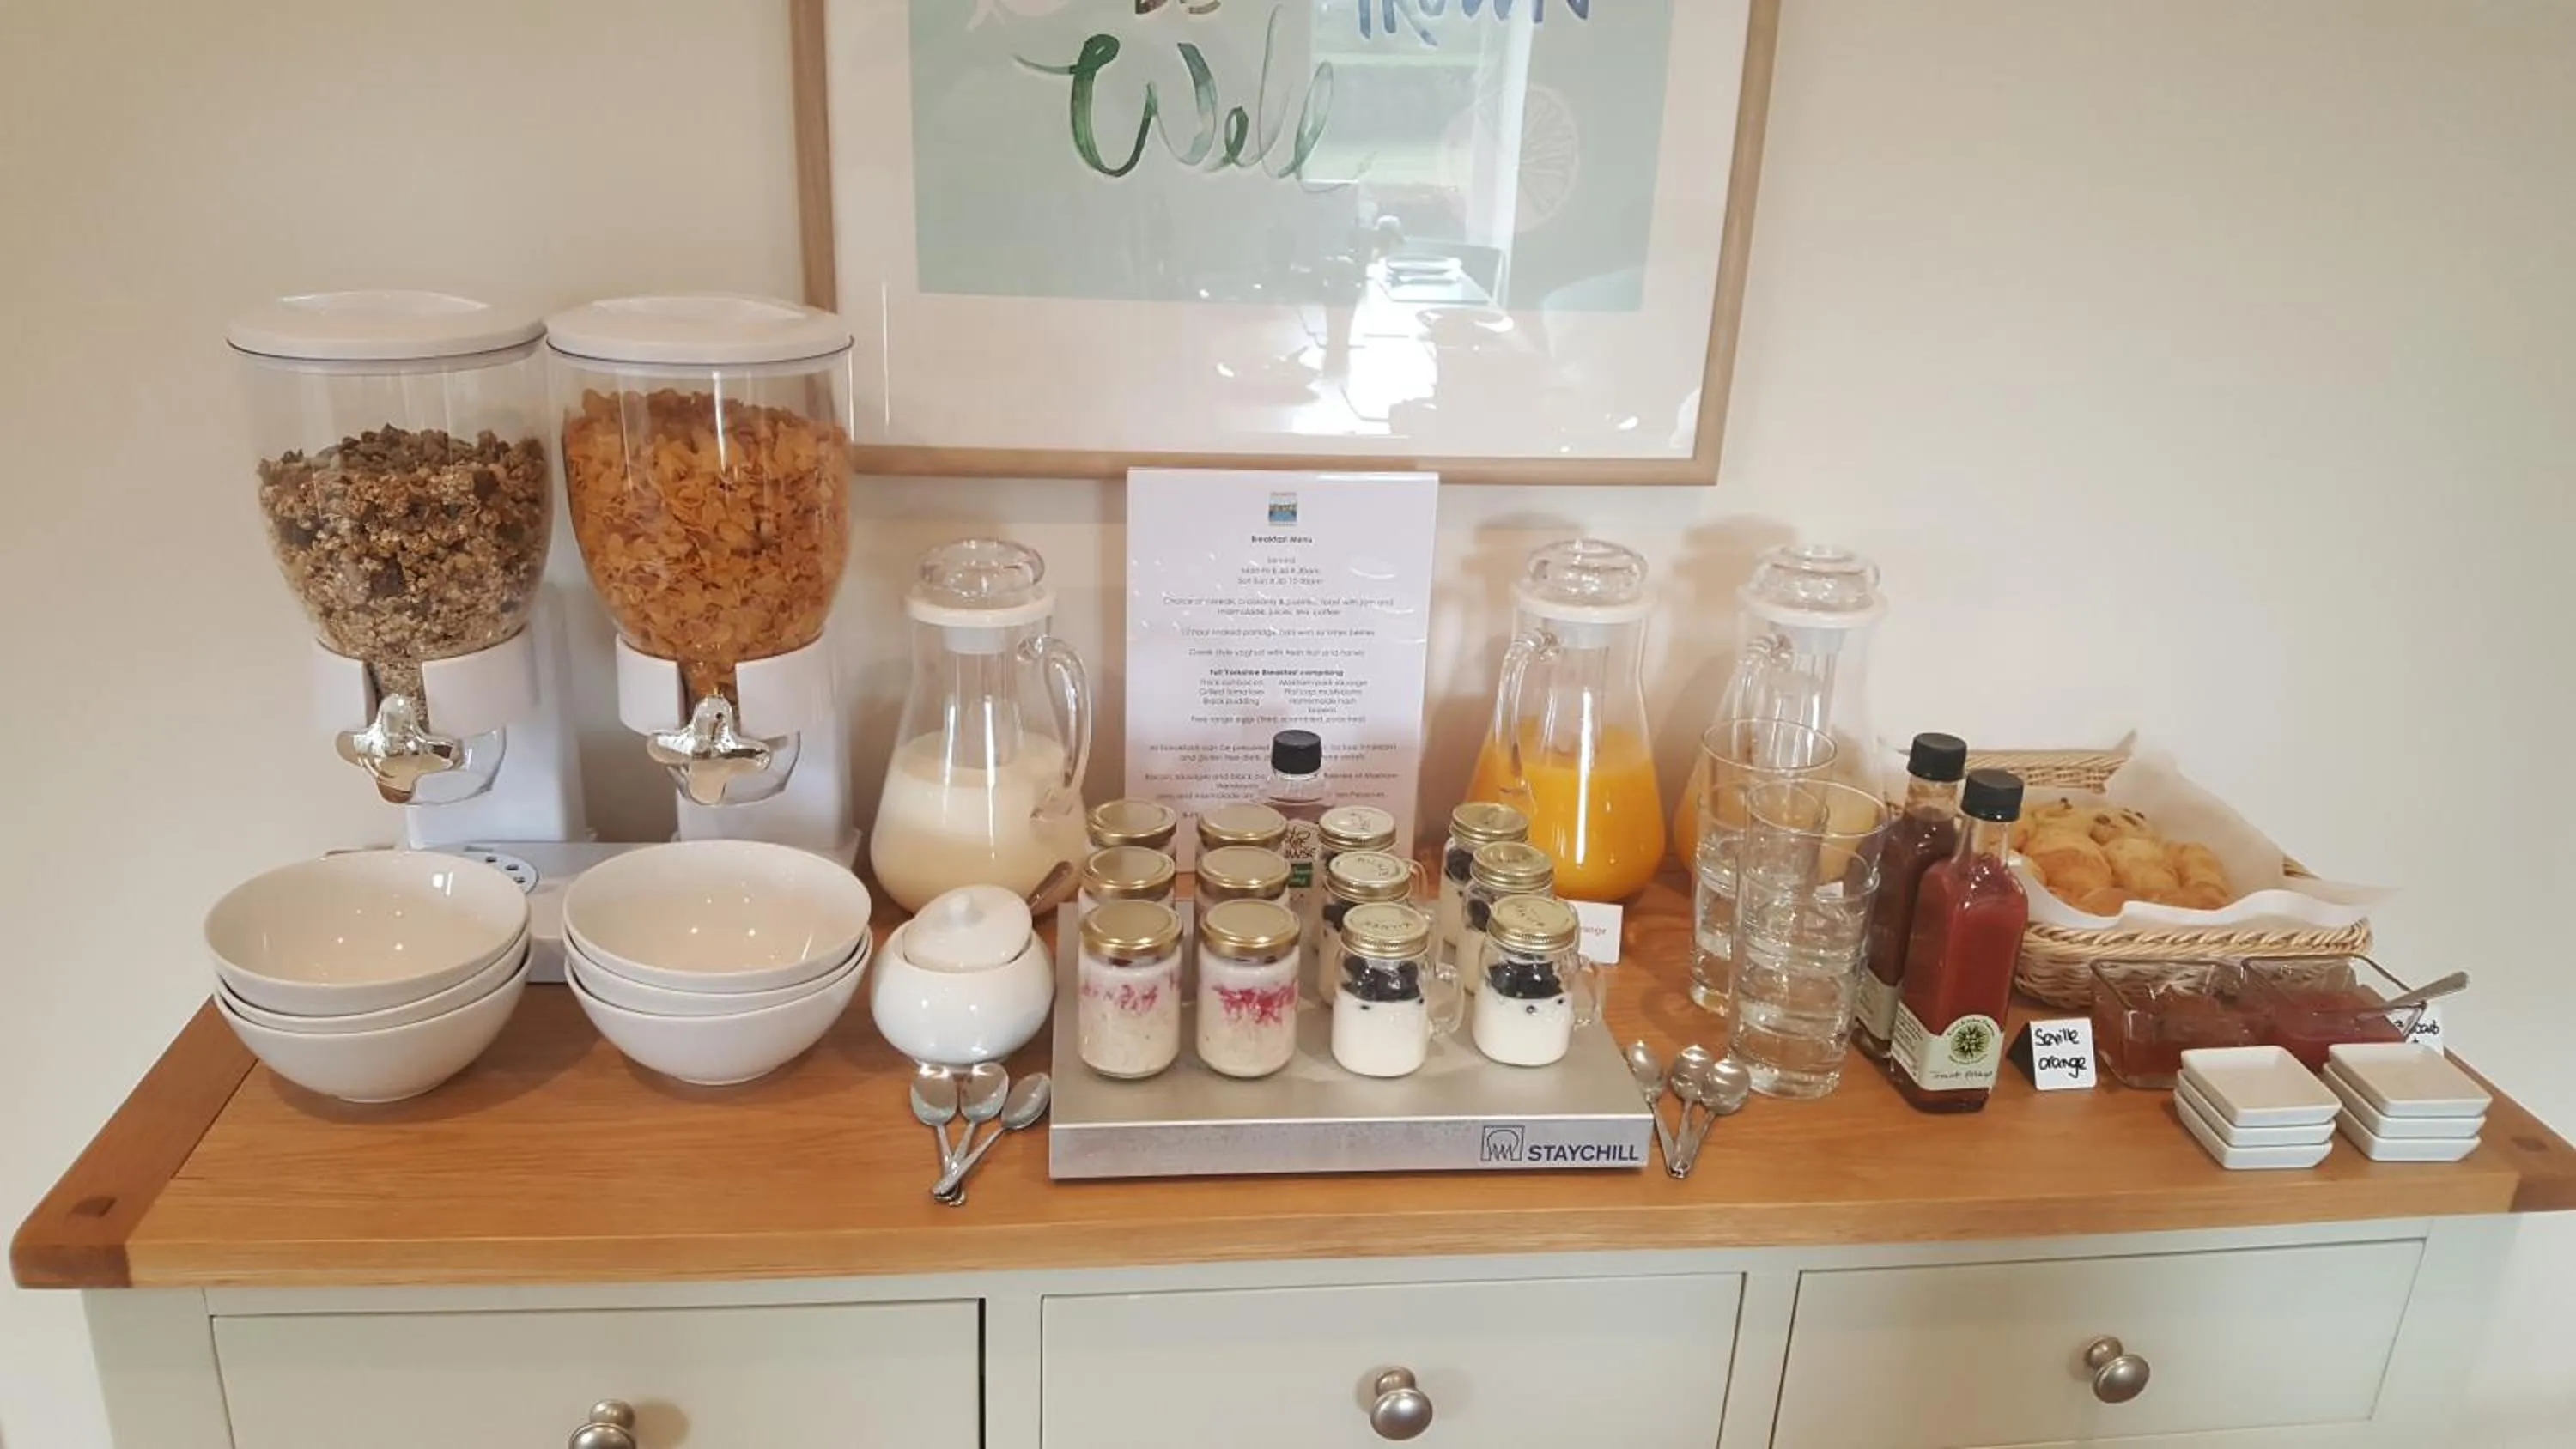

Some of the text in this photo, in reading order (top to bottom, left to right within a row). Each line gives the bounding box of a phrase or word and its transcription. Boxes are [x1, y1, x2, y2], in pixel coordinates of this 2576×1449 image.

[1013, 4, 1376, 193] Well
[2035, 1028, 2080, 1046] Seville
[1528, 1144, 1640, 1161] STAYCHILL
